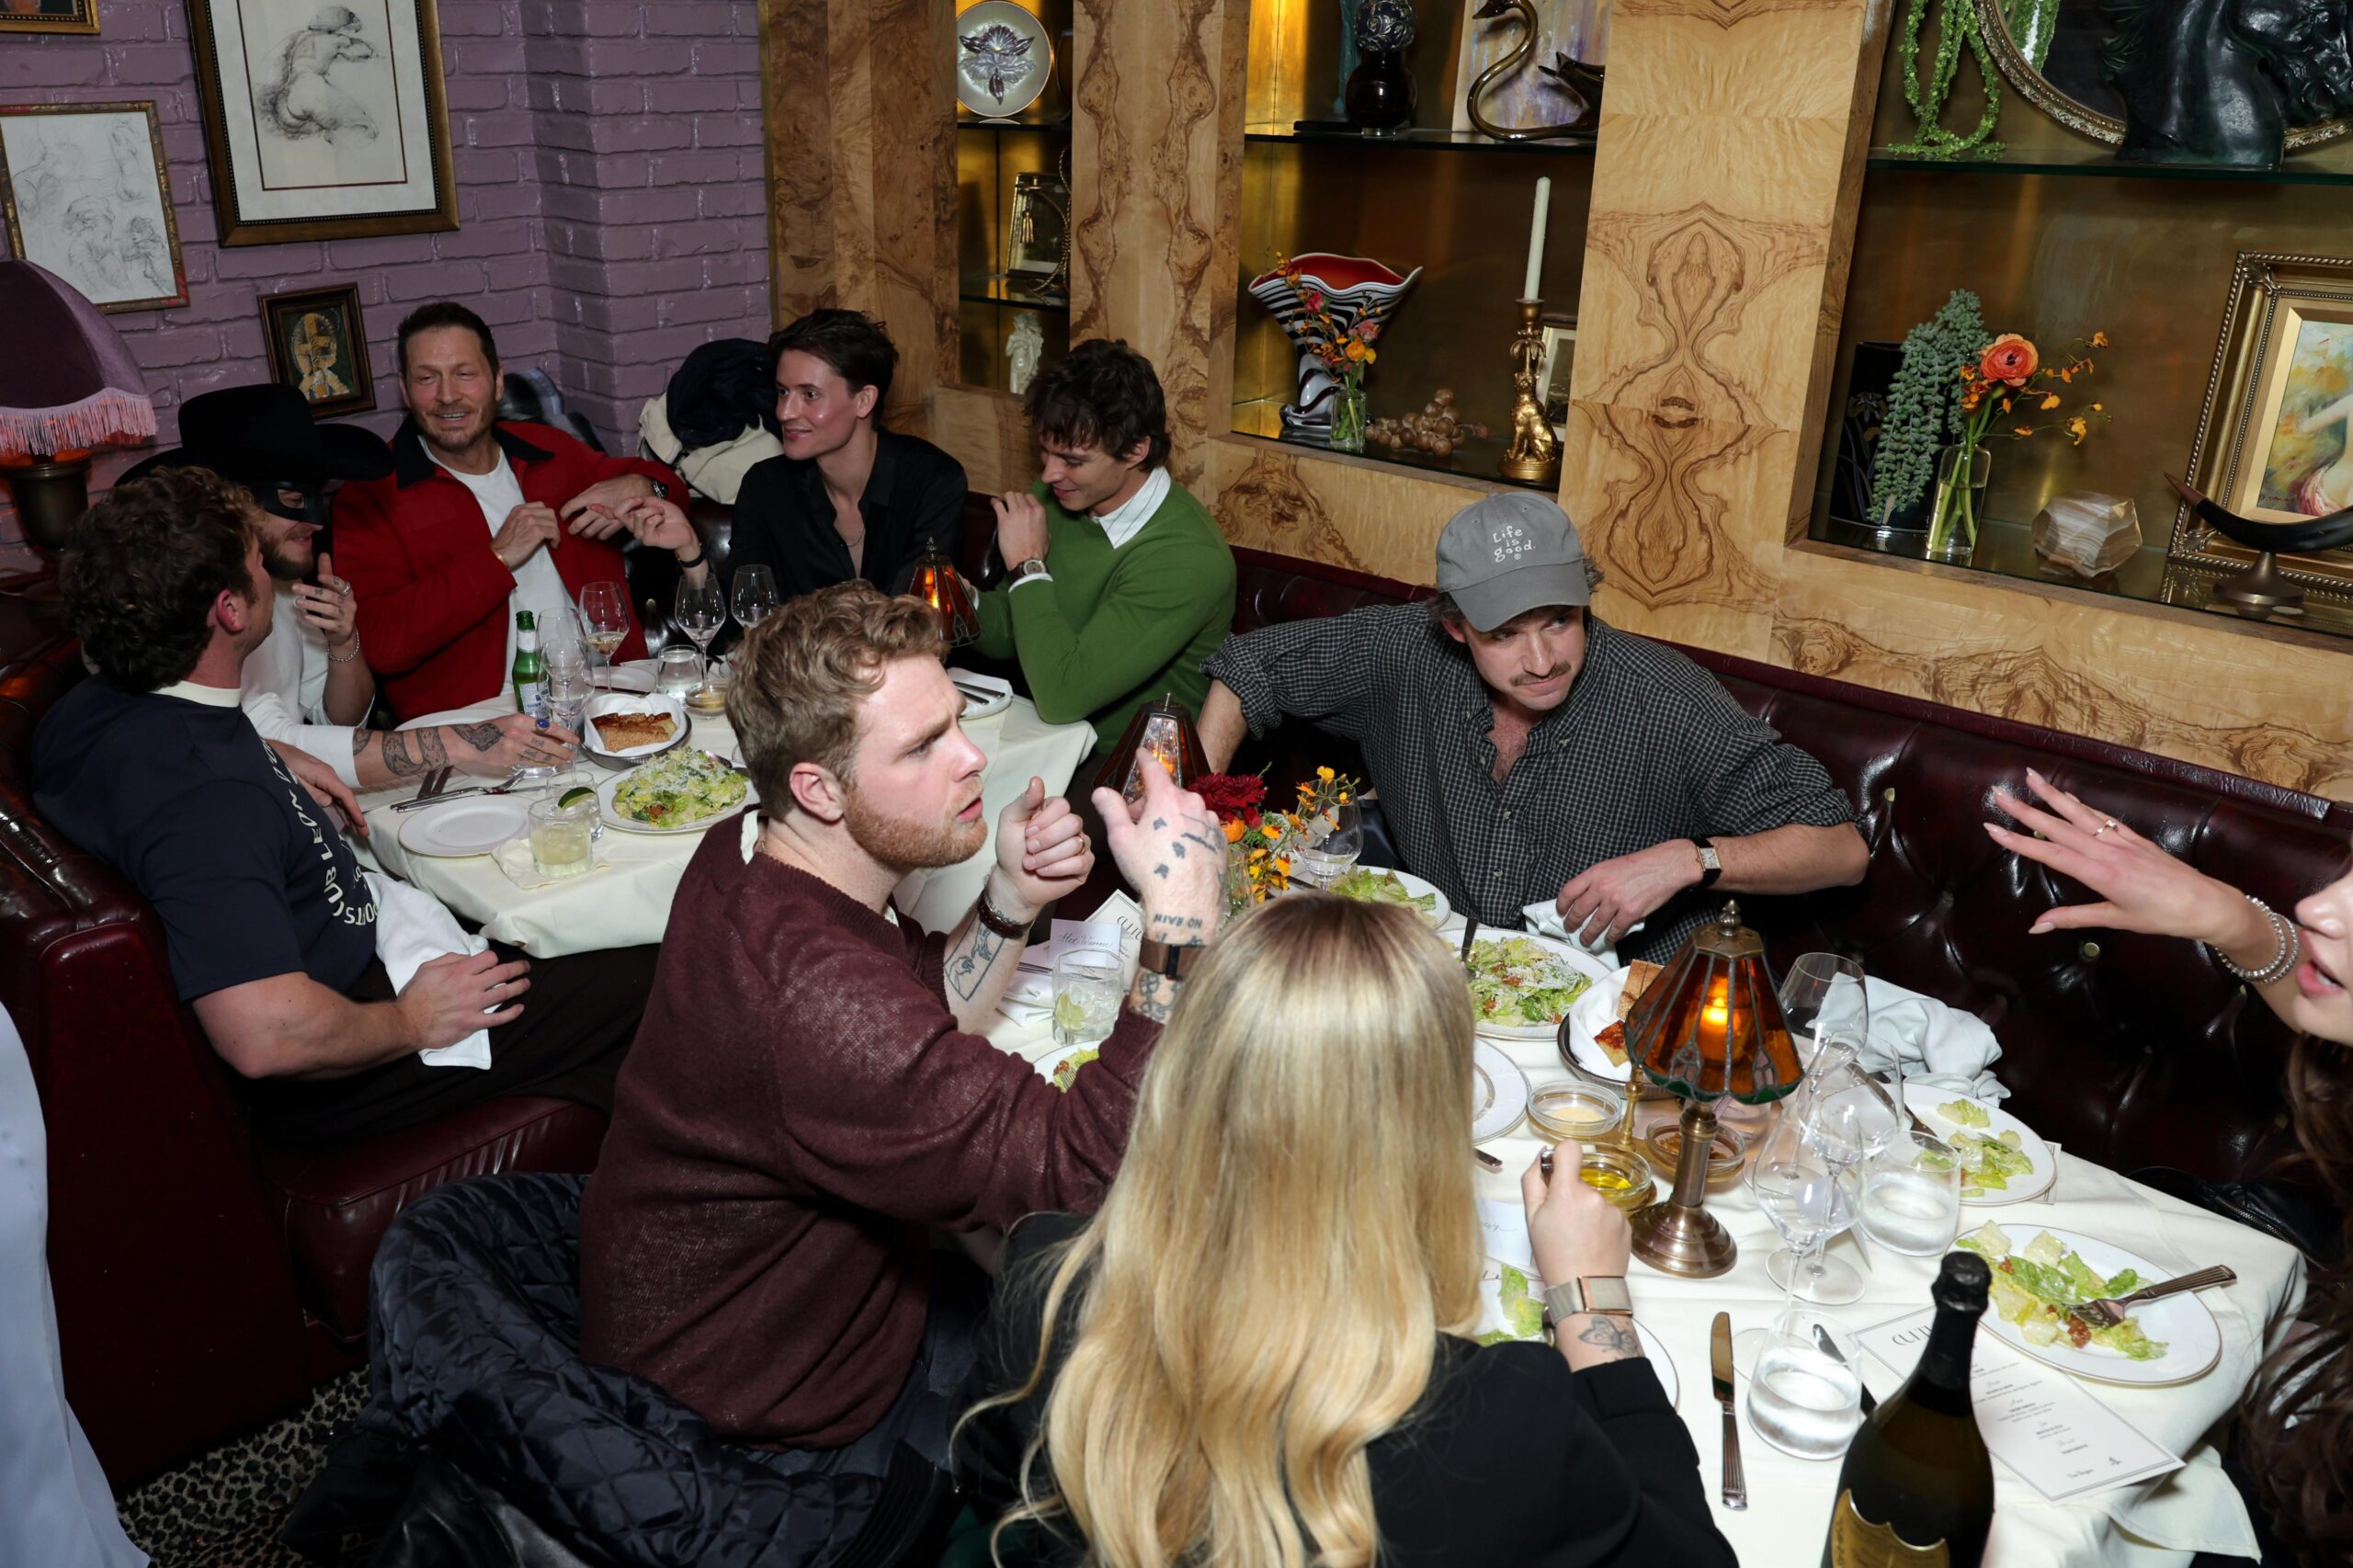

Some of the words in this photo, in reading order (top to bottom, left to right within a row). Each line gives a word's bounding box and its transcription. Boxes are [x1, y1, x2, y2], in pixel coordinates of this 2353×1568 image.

[1493, 525, 1523, 543] Life
[1506, 539, 1519, 548] is
[1153, 913, 1185, 927] RAIN
[1187, 916, 1203, 929] NO
[1056, 932, 1078, 946] Alex
